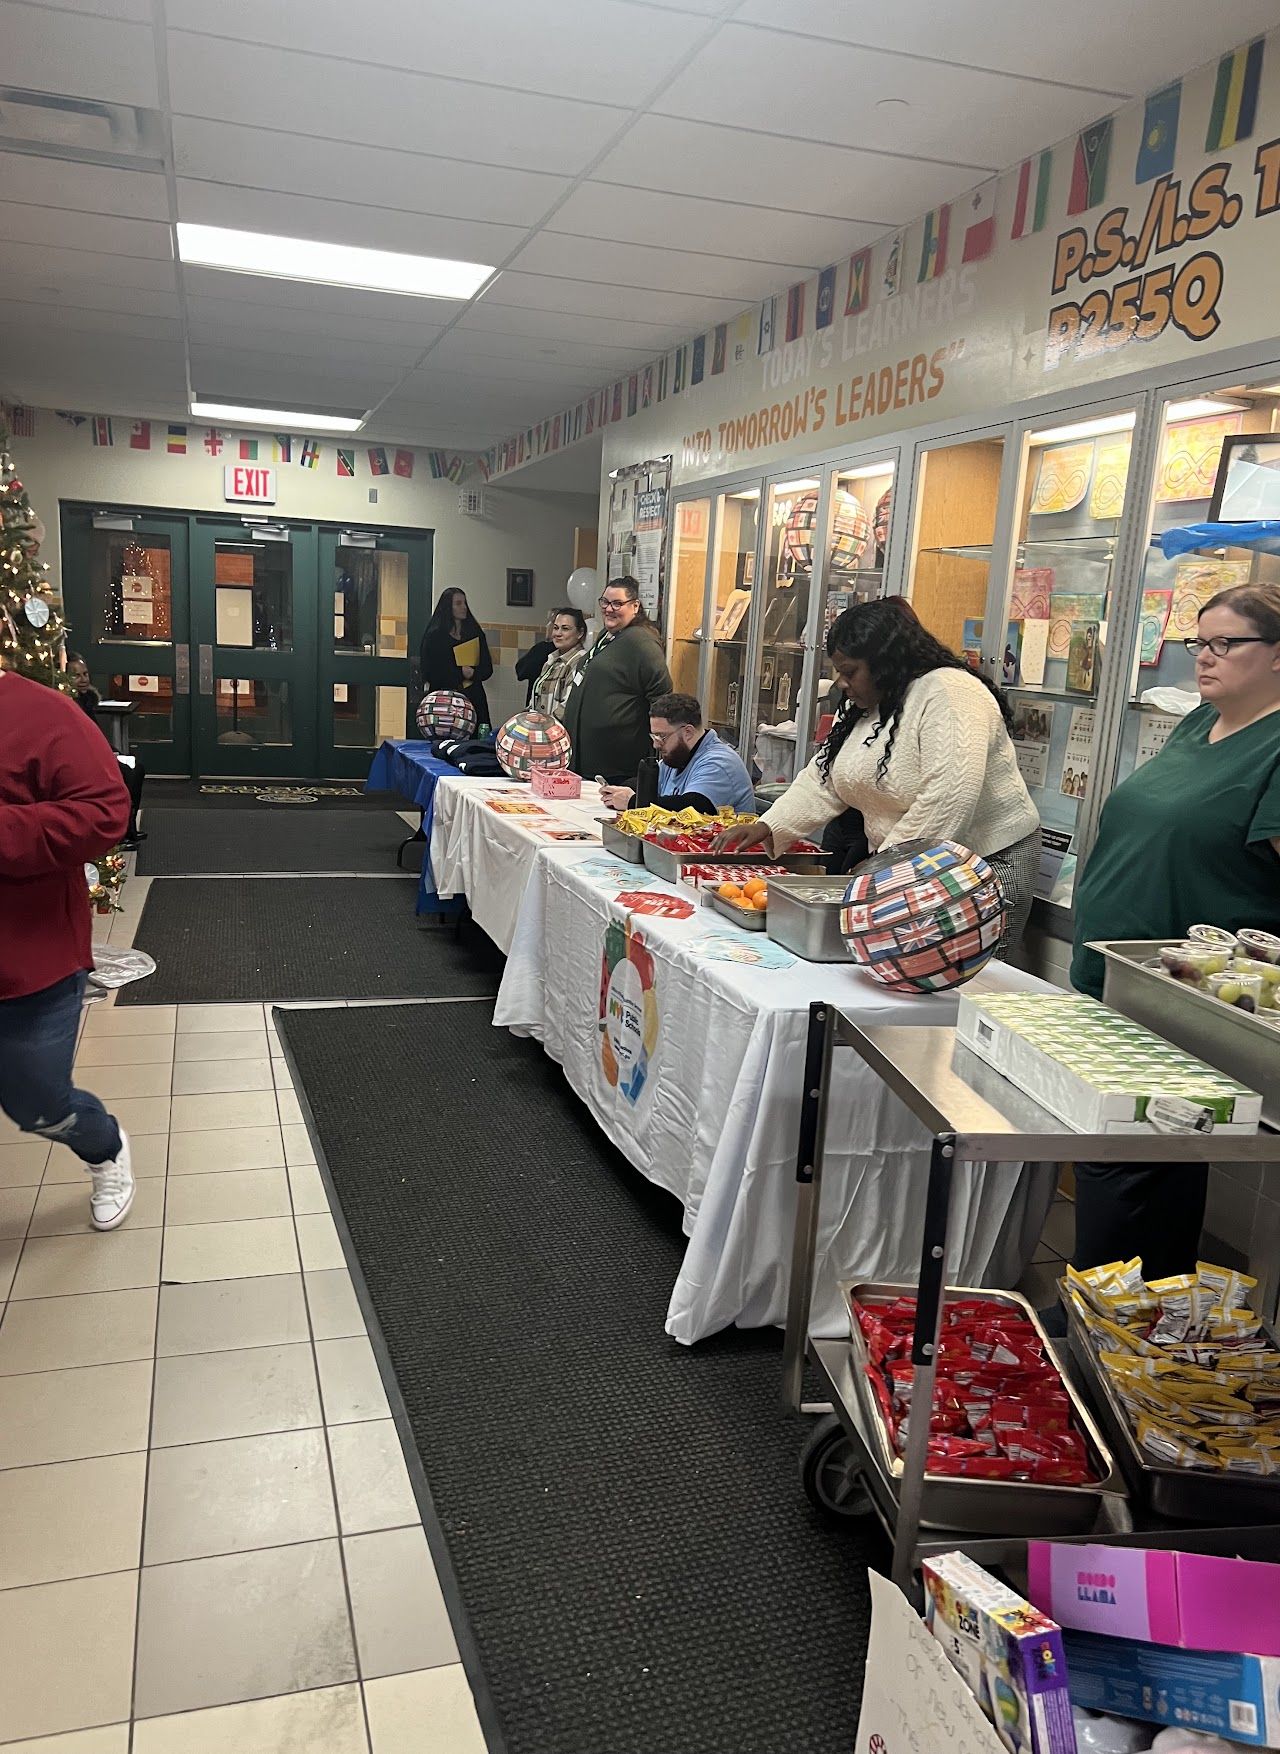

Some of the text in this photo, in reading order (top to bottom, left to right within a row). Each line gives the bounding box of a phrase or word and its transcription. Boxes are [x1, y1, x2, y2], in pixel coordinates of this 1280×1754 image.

[841, 264, 978, 362] LEARNERS
[1042, 251, 1223, 373] P255Q
[718, 386, 827, 455] TOMORROW'S
[234, 467, 270, 497] EXIT
[1077, 1586, 1116, 1605] LLAMA
[958, 1614, 981, 1640] ZONE
